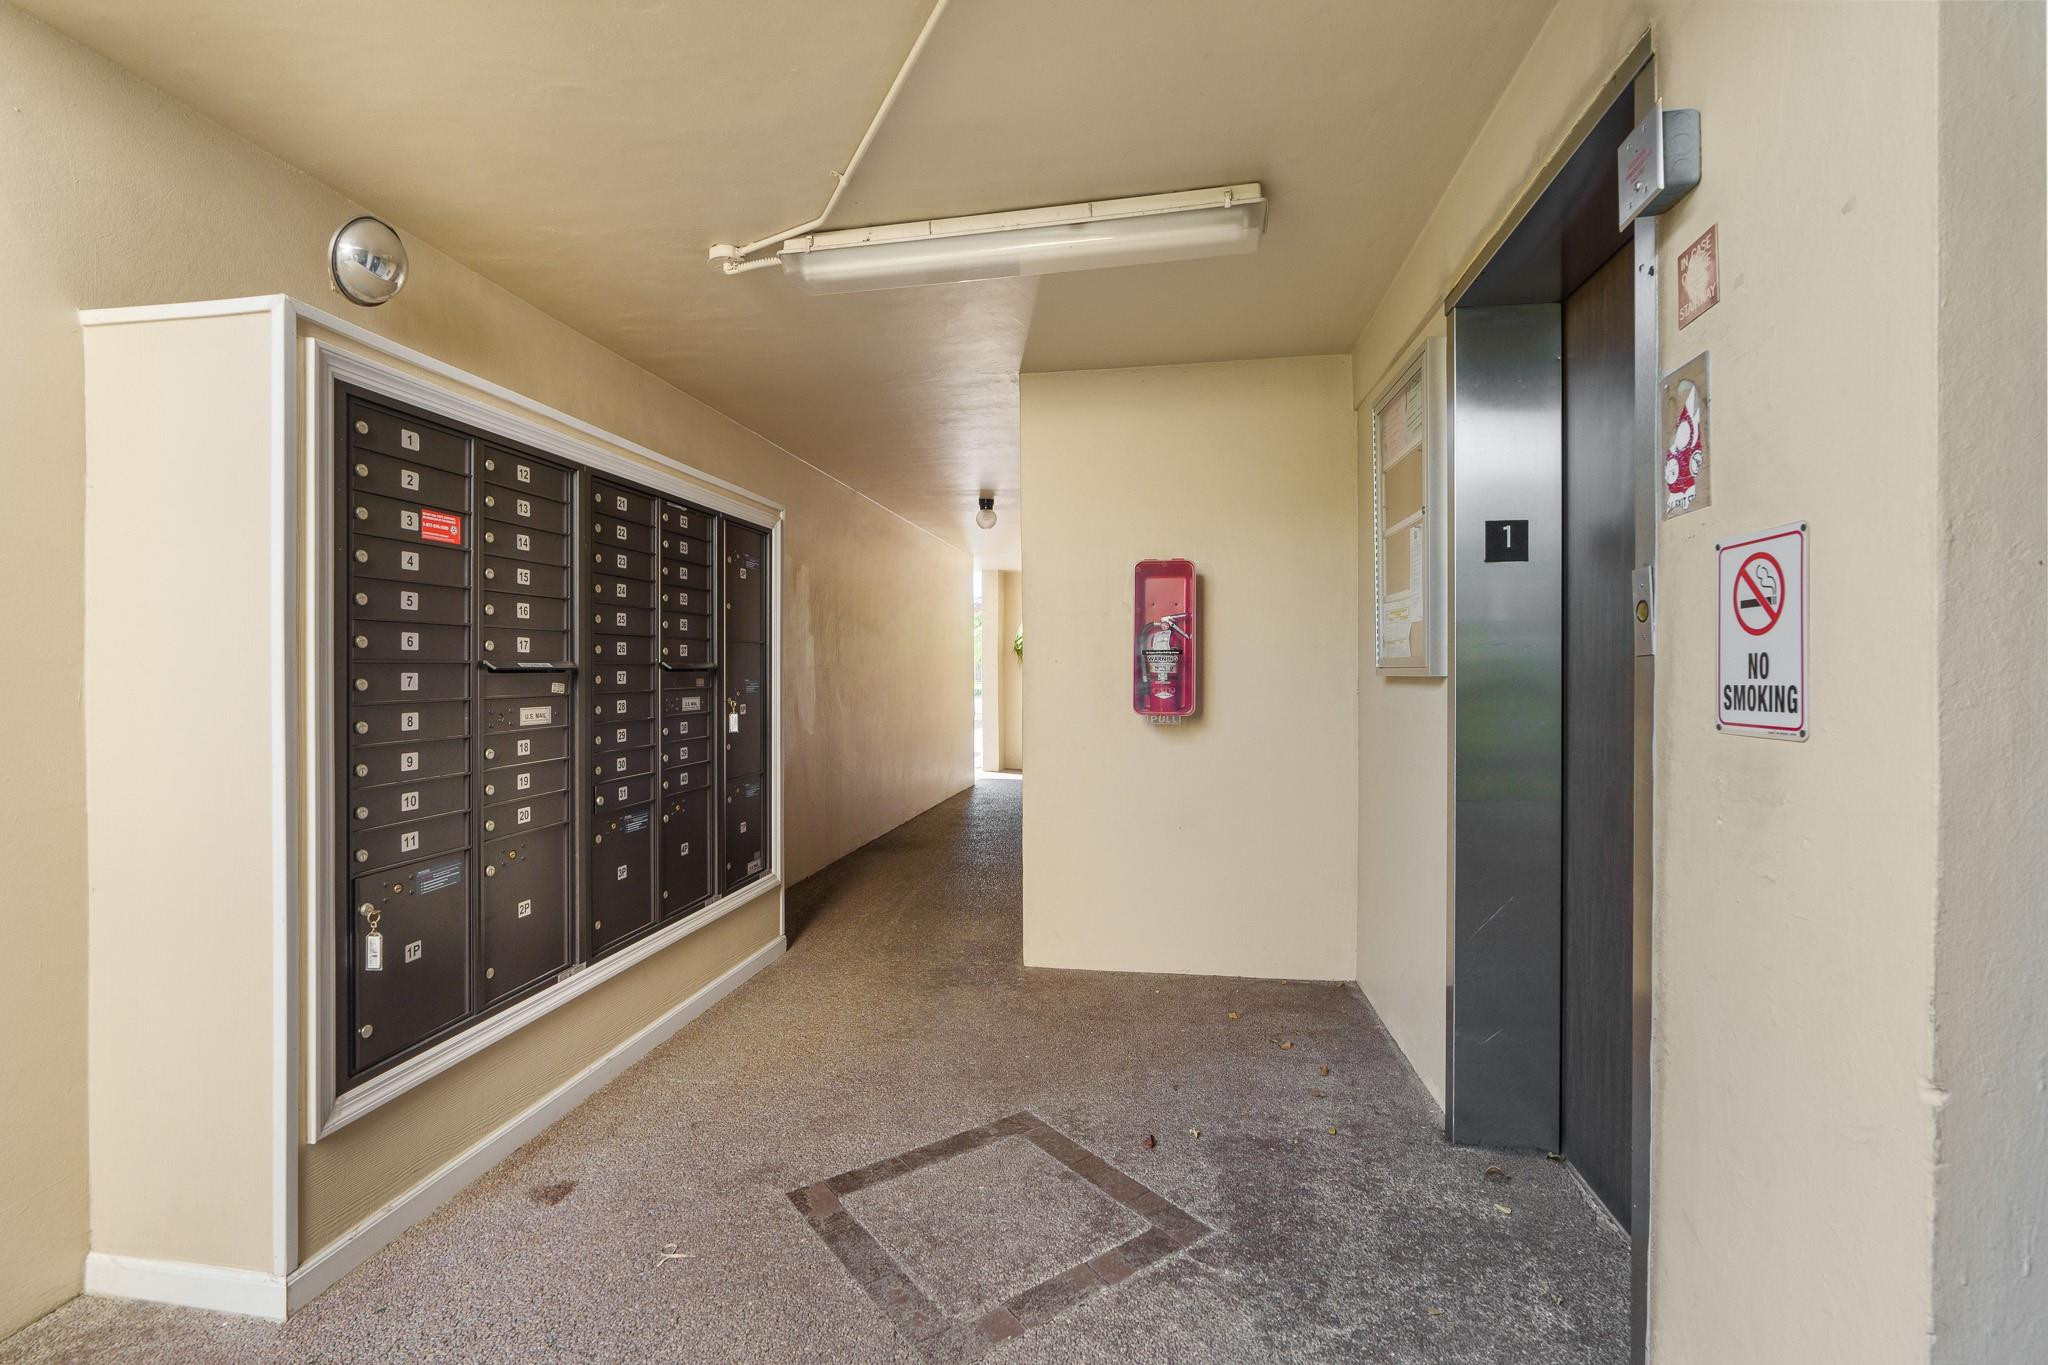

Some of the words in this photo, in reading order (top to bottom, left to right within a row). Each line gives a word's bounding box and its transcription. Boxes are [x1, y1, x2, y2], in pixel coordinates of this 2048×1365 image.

[1680, 256, 1688, 271] IN
[519, 468, 529, 480] 12
[407, 474, 414, 486] 2
[518, 503, 528, 514] 13
[618, 499, 625, 509] 21
[406, 514, 413, 527] 3
[618, 528, 625, 538] 22
[1502, 525, 1511, 548] 1
[518, 537, 528, 548] 14
[406, 555, 414, 567] 4
[618, 557, 626, 566] 23
[519, 572, 529, 582] 15
[618, 586, 625, 595] 24
[406, 595, 413, 607] 5
[519, 606, 528, 616] 16
[618, 615, 626, 624] 25
[407, 635, 414, 647] 6
[519, 640, 528, 650] 17
[618, 644, 625, 653] 26
[1748, 652, 1769, 679] NO
[406, 676, 413, 687] 7
[618, 673, 625, 682] 27
[1724, 684, 1798, 713] SMOKING
[618, 702, 625, 711] 28
[407, 716, 413, 727] 8
[618, 731, 625, 740] 29
[519, 742, 529, 753] 18
[406, 756, 413, 768] 9
[618, 760, 625, 769] 30
[519, 776, 529, 787] 19
[620, 789, 626, 798] 31
[404, 795, 417, 808] 10
[519, 809, 529, 821] 20
[404, 834, 416, 848] 11
[618, 867, 627, 878] 3P
[519, 902, 530, 915] 2P
[407, 944, 420, 959] 1P
